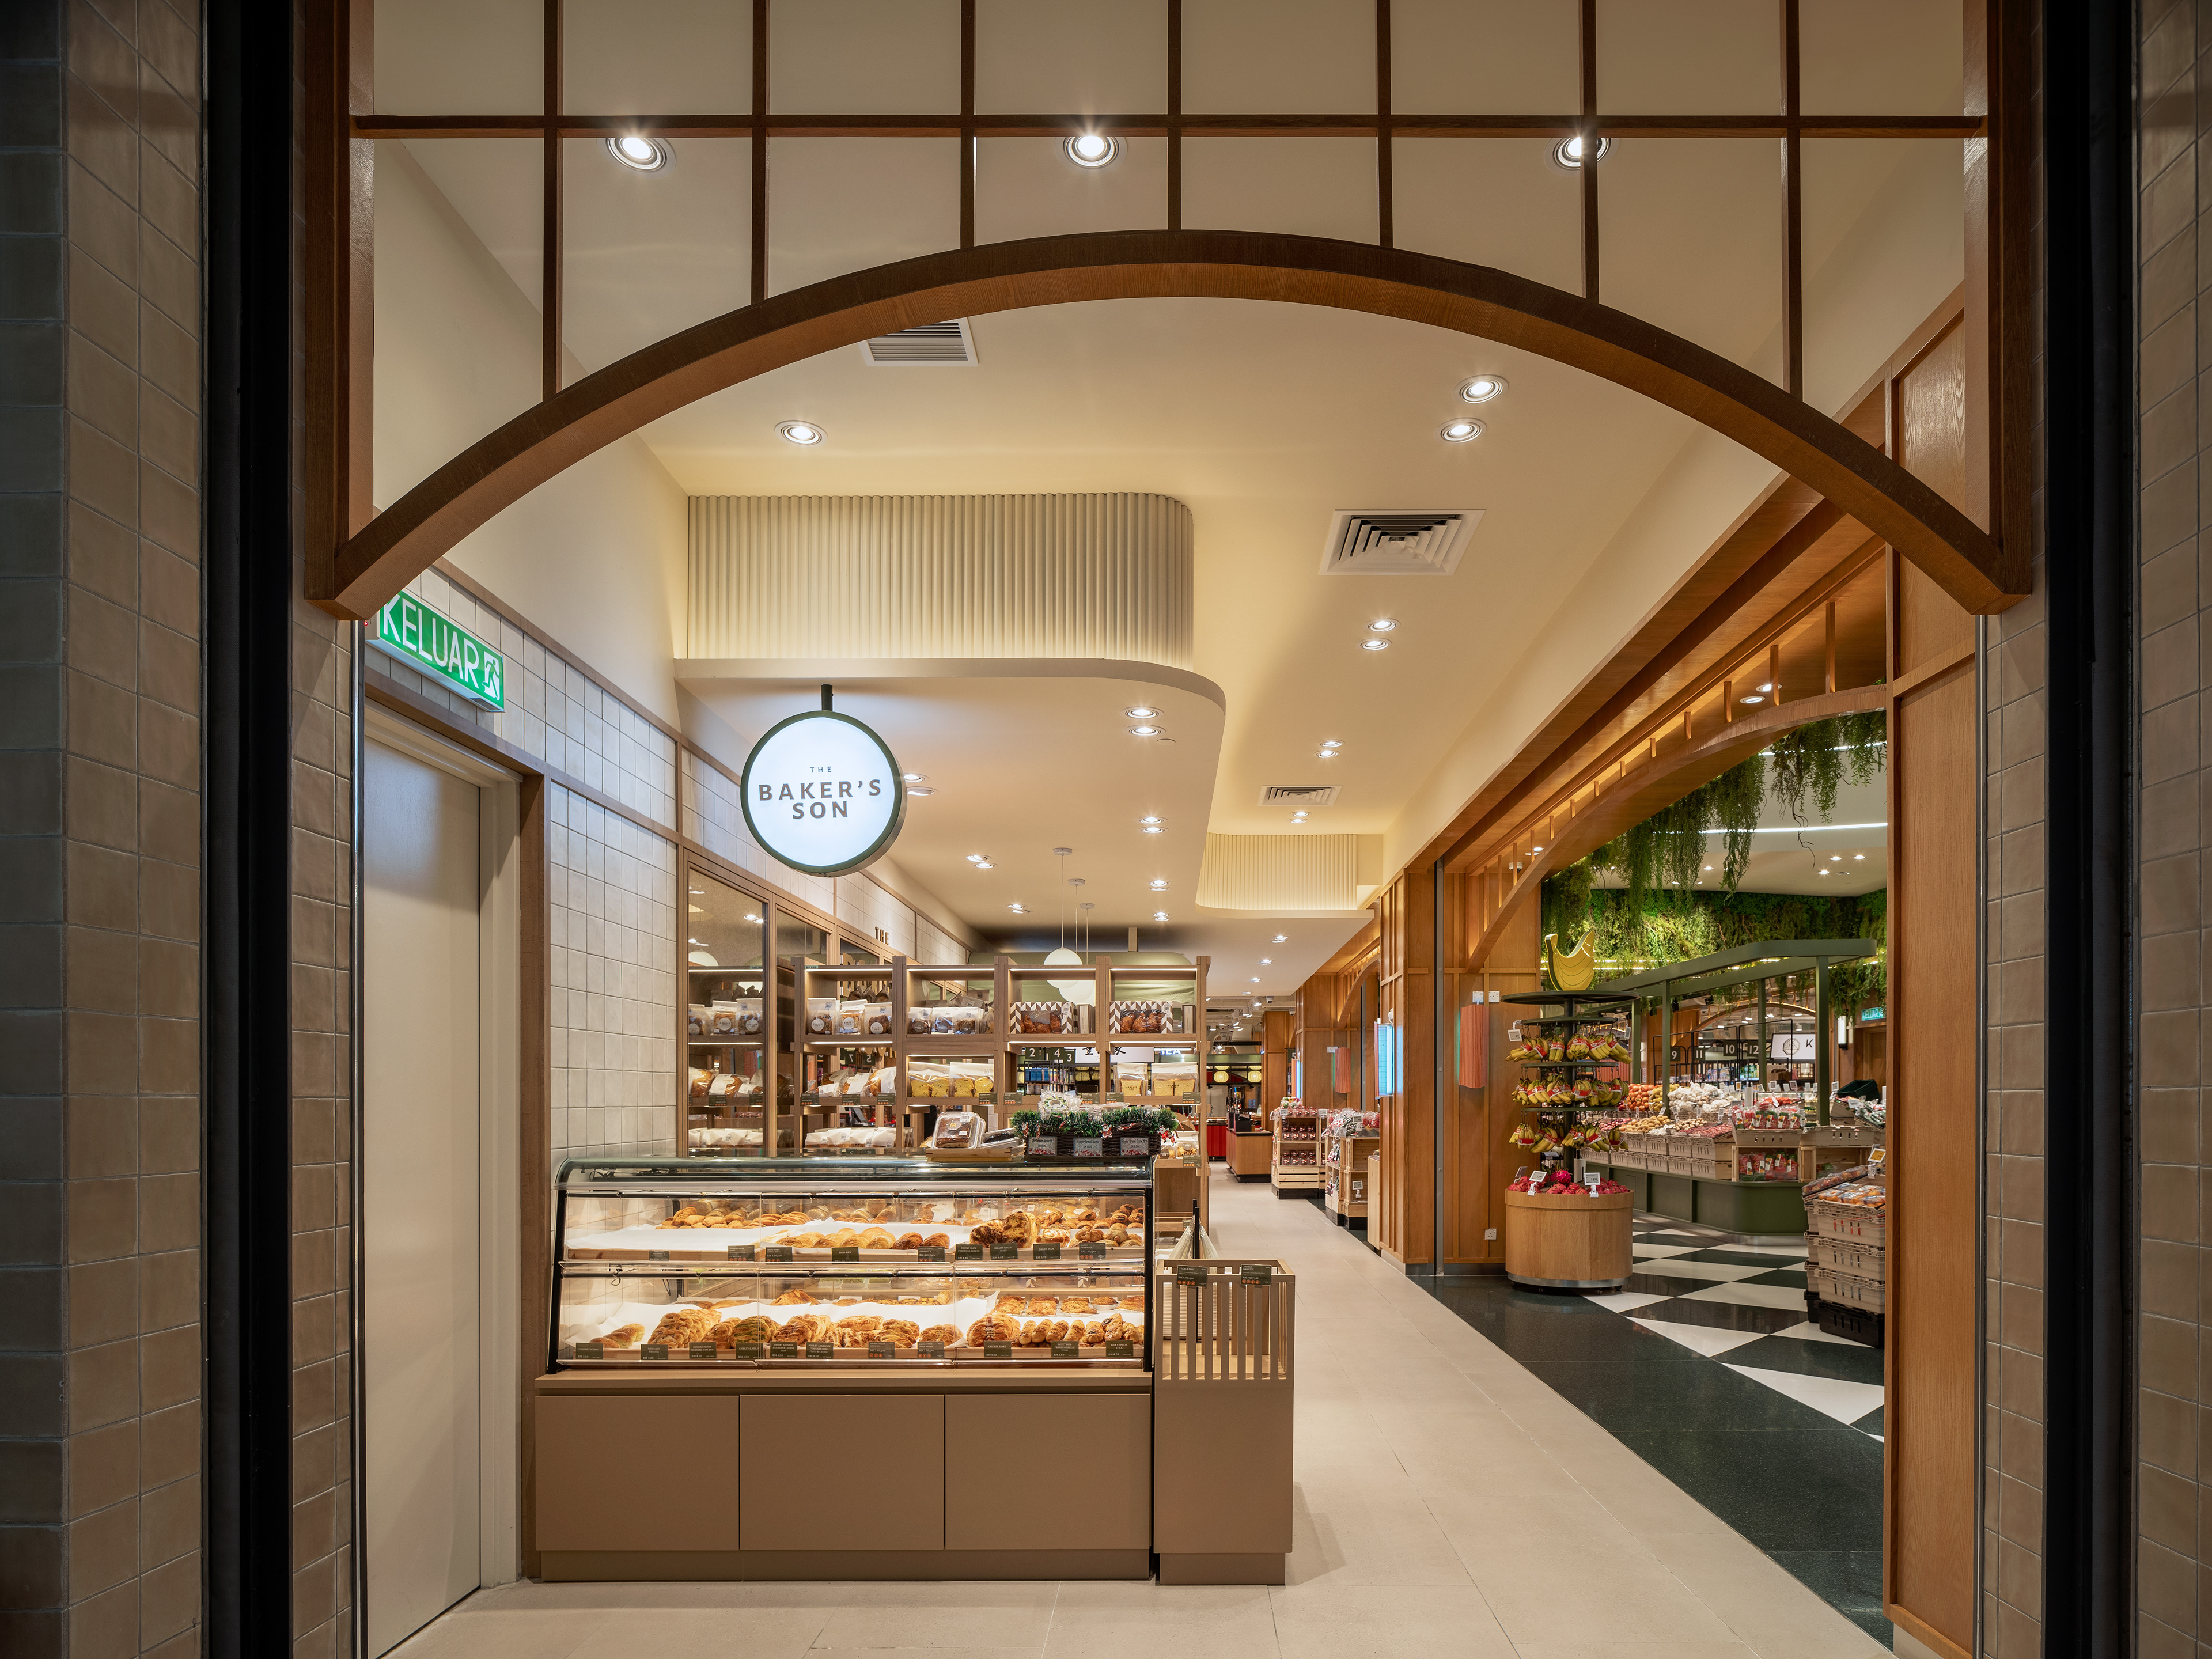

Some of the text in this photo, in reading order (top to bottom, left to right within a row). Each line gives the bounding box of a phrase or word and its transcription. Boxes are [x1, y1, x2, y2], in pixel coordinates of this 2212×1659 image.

[383, 594, 479, 689] KELUAR
[759, 779, 881, 801] BAKER'S
[793, 801, 847, 819] SON
[875, 926, 889, 945] THE
[1029, 1048, 1036, 1057] 2
[1054, 1048, 1060, 1058] 4
[1726, 1044, 1735, 1054] 10
[1749, 1045, 1759, 1054] 12
[1067, 1054, 1072, 1062] 3
[1672, 1051, 1677, 1059] 9
